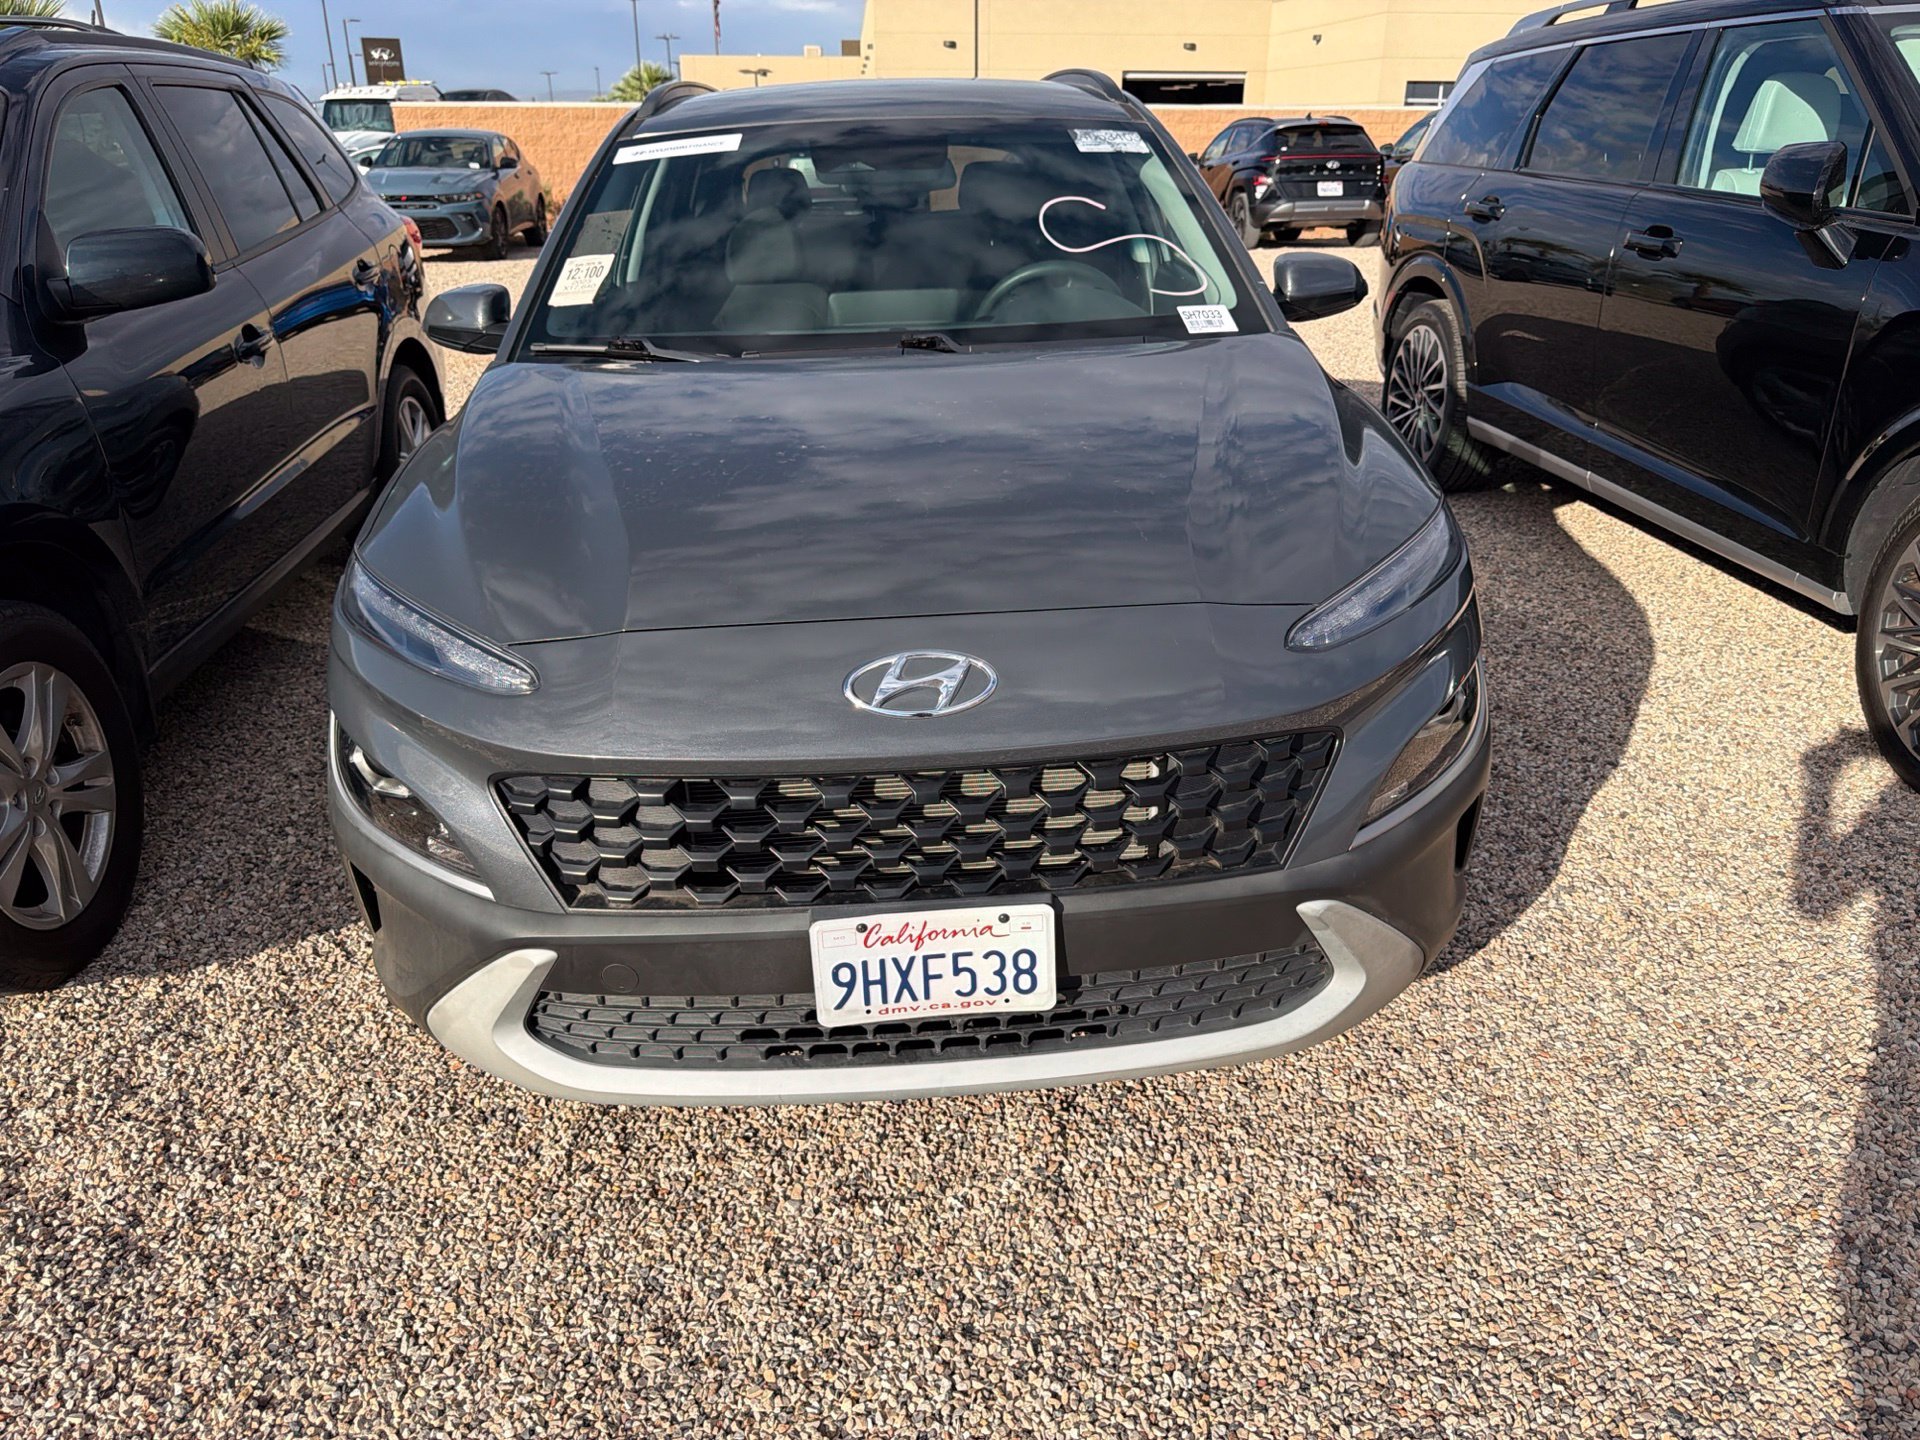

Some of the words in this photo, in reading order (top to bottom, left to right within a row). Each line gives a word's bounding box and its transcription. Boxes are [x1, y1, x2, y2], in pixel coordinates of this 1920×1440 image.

[567, 265, 604, 281] 12:100
[1182, 309, 1223, 320] SH7033
[863, 920, 1010, 952] California
[831, 948, 1038, 1011] 9HXF538
[878, 999, 997, 1016] dmv.ca.gov
